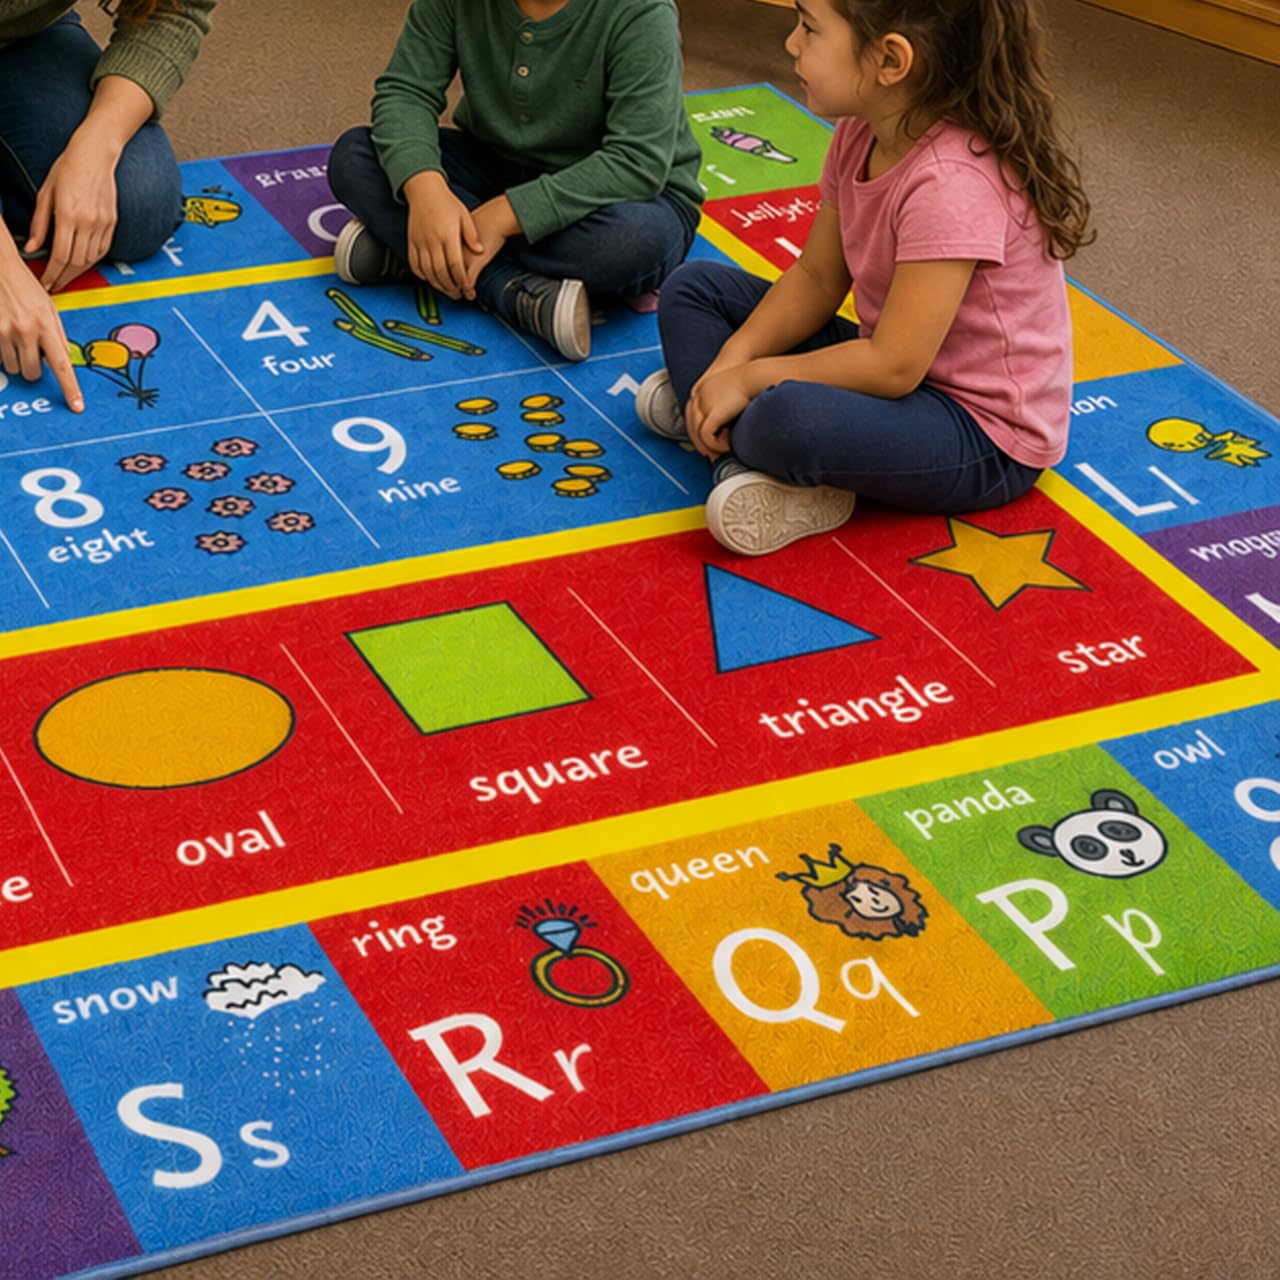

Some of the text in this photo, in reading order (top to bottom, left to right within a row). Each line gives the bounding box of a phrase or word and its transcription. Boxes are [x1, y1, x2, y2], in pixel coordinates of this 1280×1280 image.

[242, 301, 309, 346] 4
[261, 349, 338, 379] four
[332, 417, 406, 474] 9
[21, 468, 105, 528] 8
[378, 472, 463, 505] nine
[47, 524, 156, 565] eight
[1058, 636, 1145, 672] star
[760, 676, 953, 737] triangle
[1154, 729, 1225, 769] owl
[470, 746, 647, 803] square
[903, 779, 1036, 841] panda
[177, 811, 284, 865] oval
[631, 847, 768, 899] queen
[353, 916, 456, 956] ring
[53, 977, 177, 1024] snow
